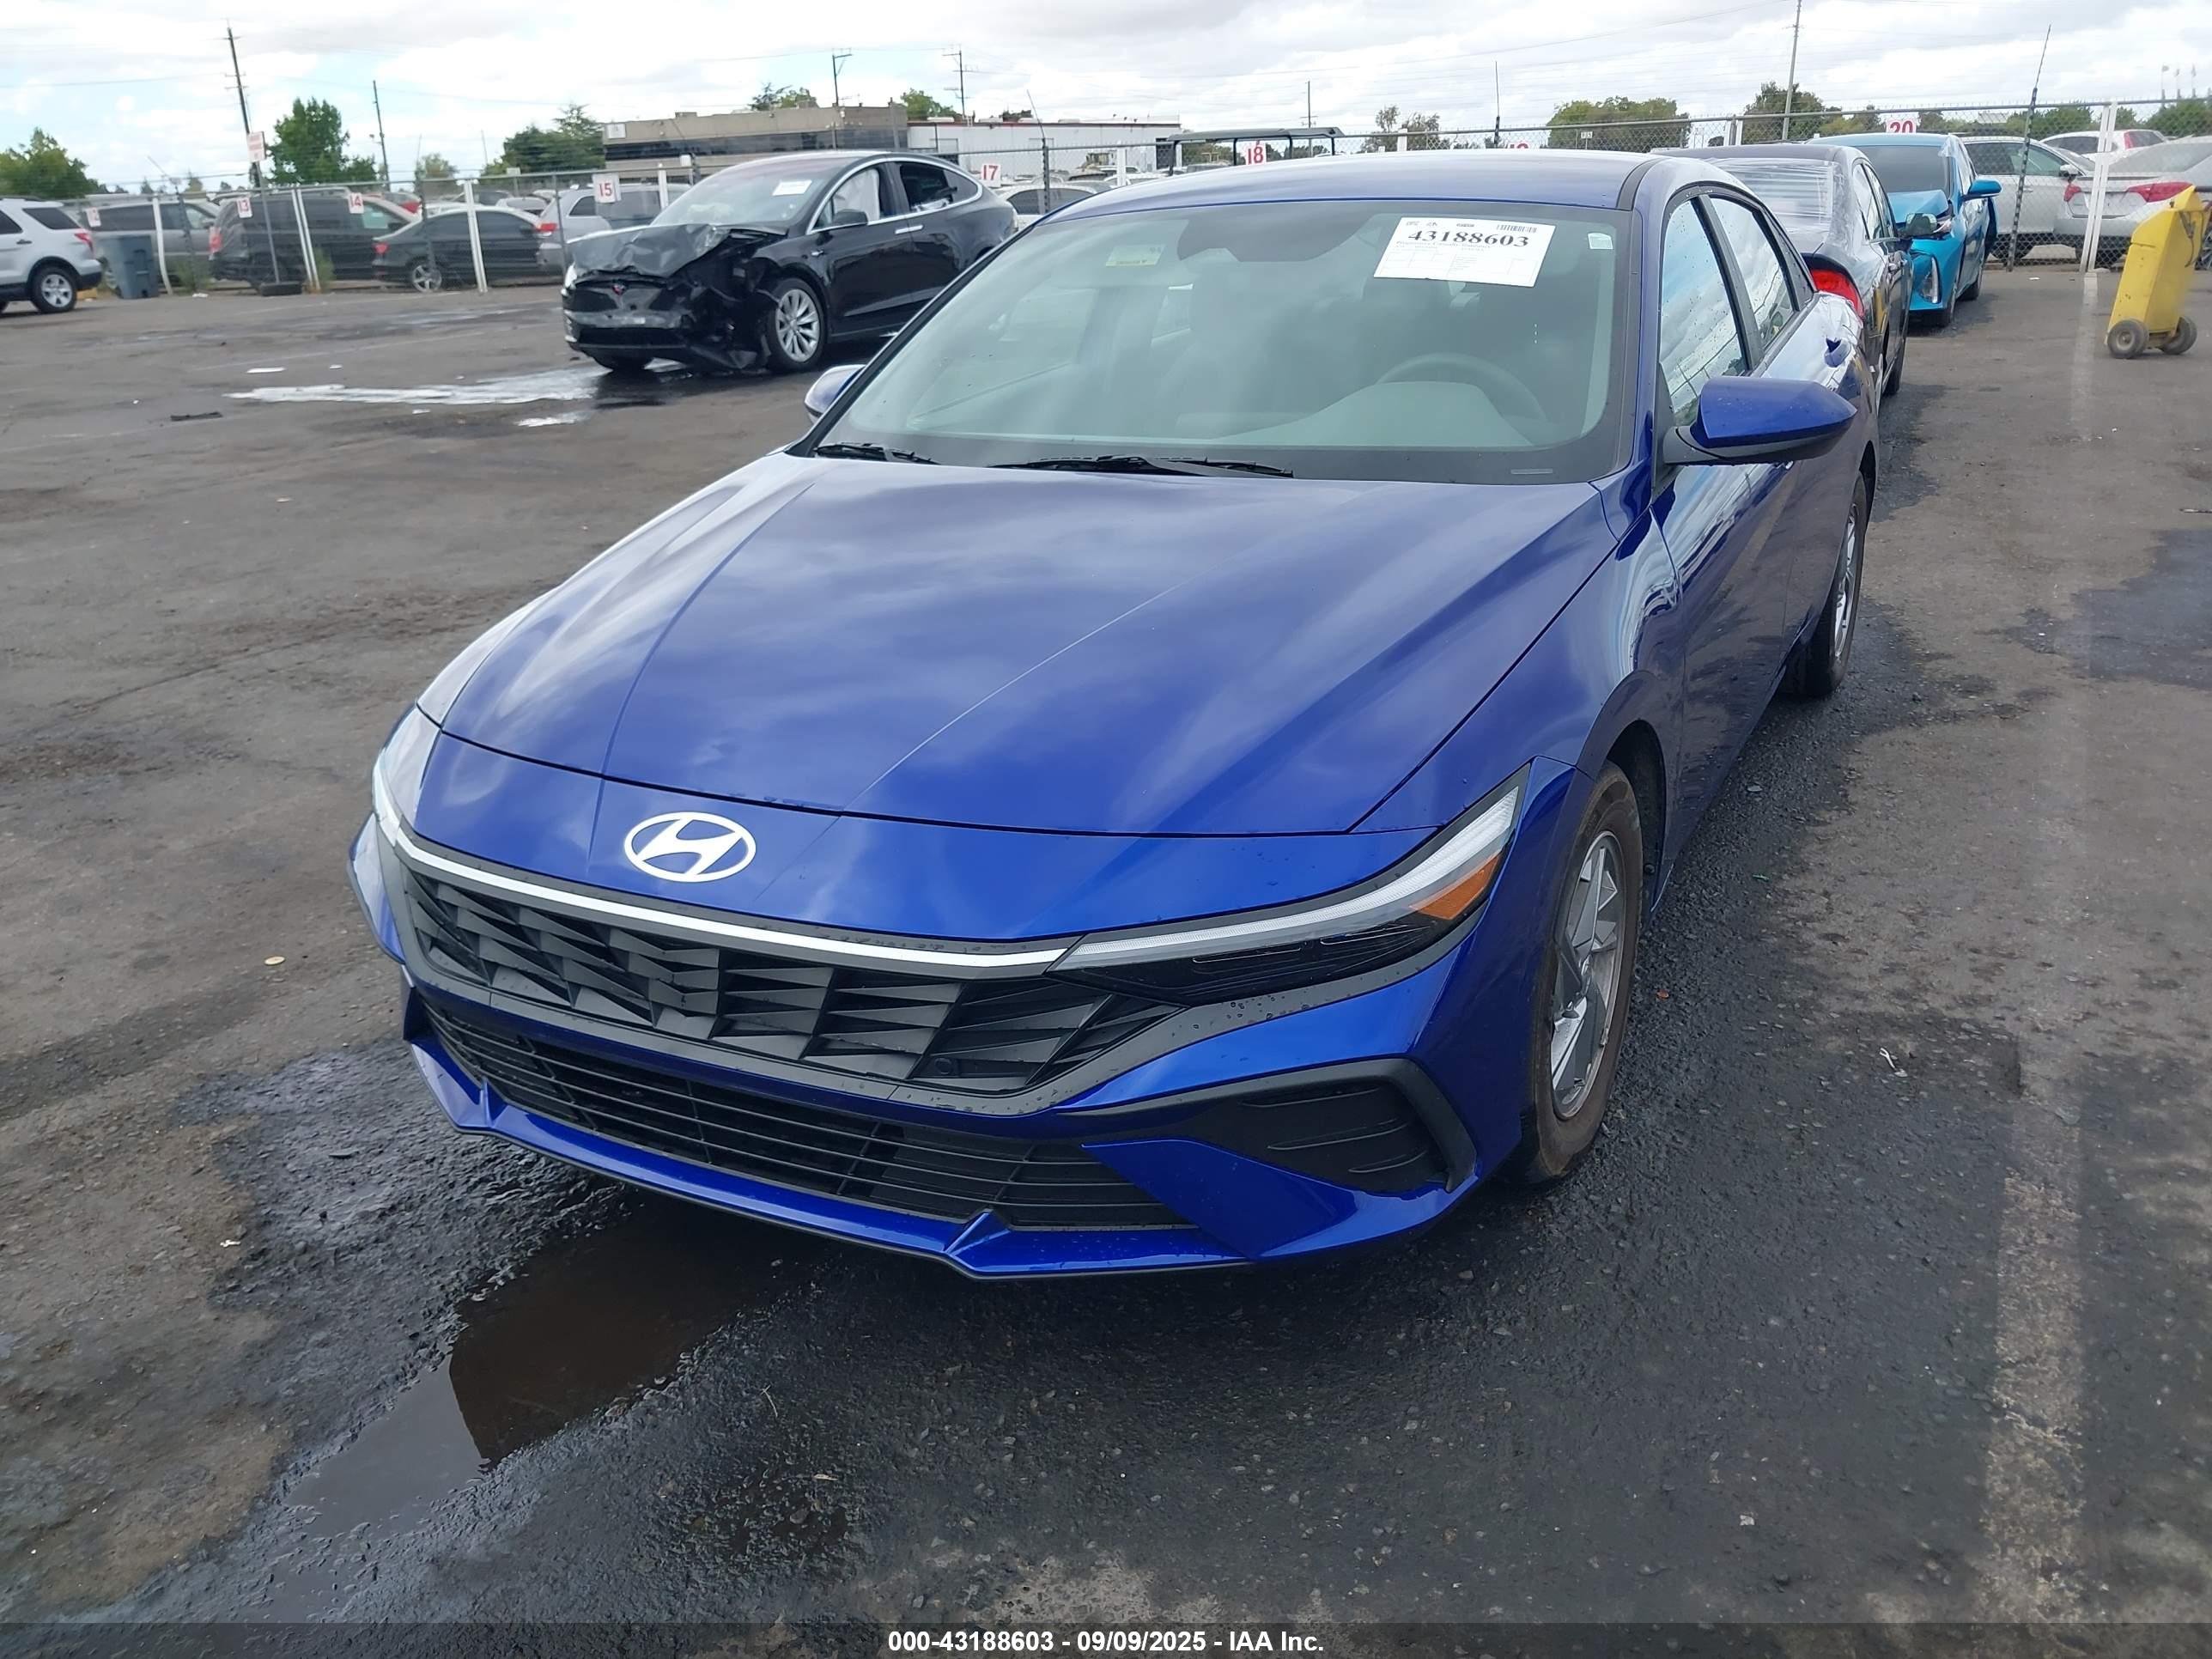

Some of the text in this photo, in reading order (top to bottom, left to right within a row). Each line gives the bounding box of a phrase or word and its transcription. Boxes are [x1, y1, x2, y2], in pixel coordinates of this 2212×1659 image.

[1890, 120, 1914, 133] 20
[1248, 146, 1264, 165] 18
[983, 165, 999, 180] 17
[599, 182, 613, 197] 15
[239, 199, 250, 213] 13
[349, 195, 362, 208] 14
[1408, 229, 1529, 248] 43188603
